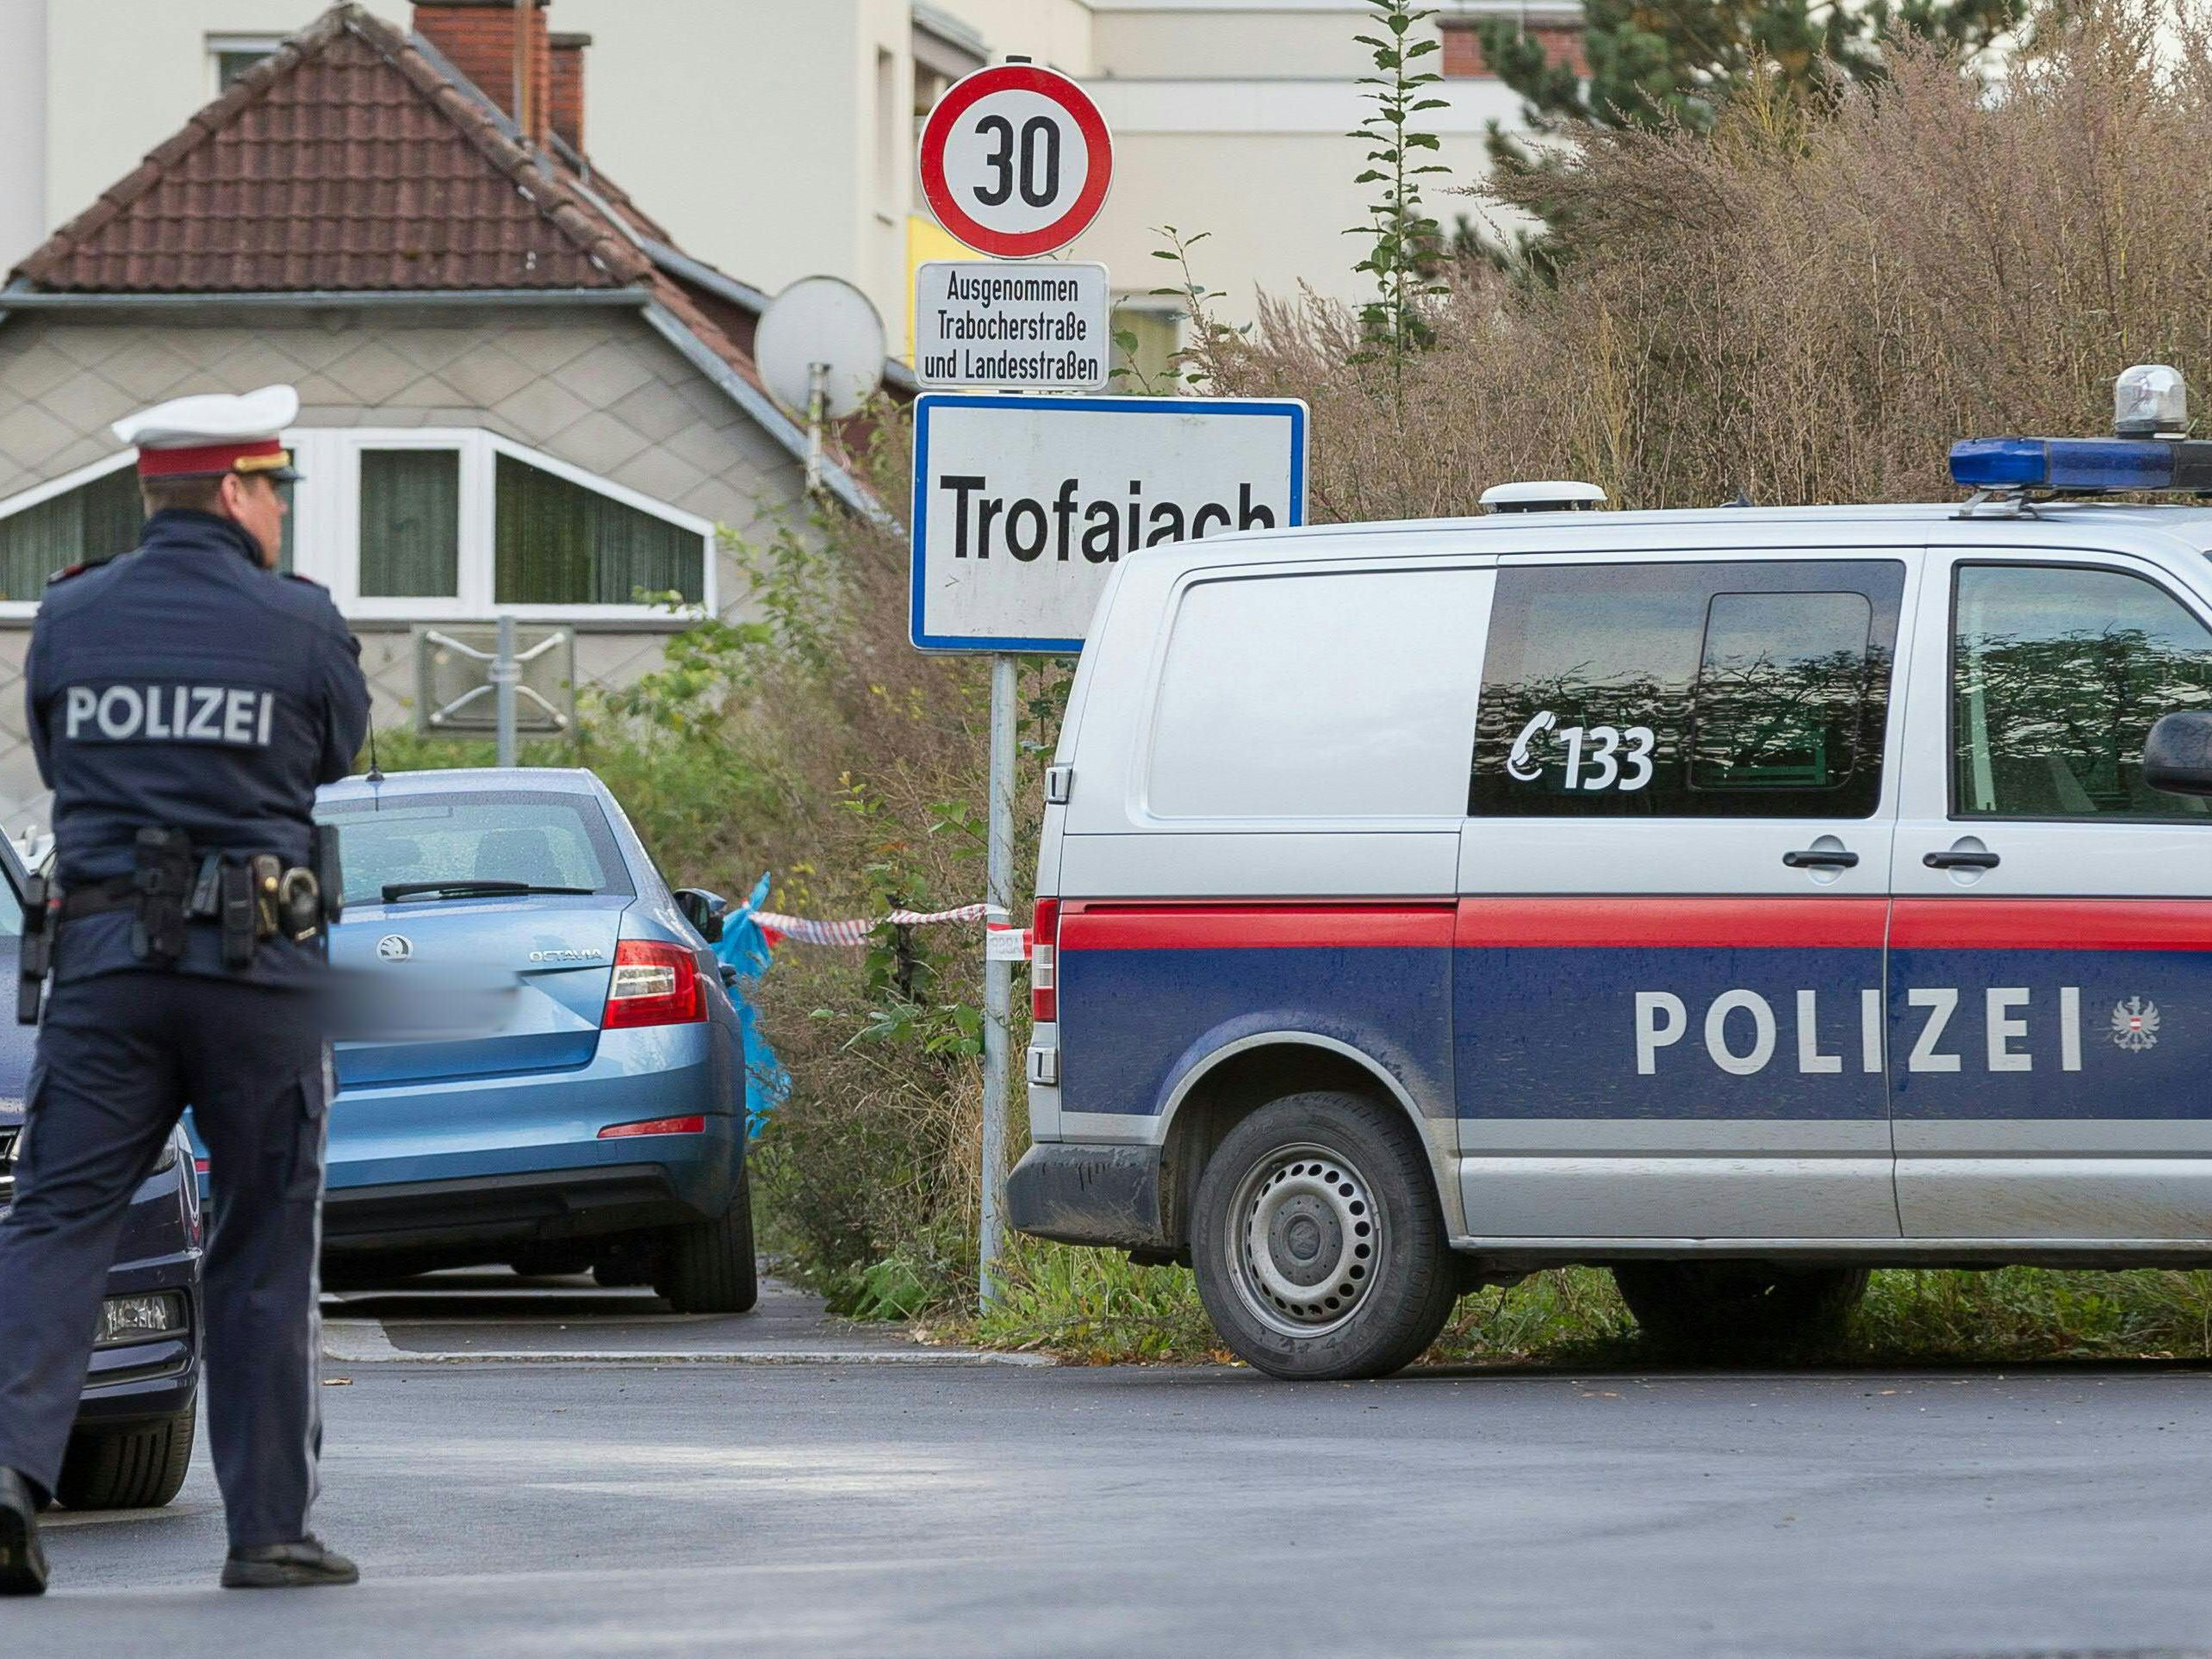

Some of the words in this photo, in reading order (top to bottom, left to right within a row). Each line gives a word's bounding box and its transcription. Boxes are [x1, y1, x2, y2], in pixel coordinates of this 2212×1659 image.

[973, 115, 1060, 207] 30
[947, 270, 1078, 308] Ausgenommen
[937, 309, 1087, 341] Trabocherstraße
[924, 348, 957, 379] und
[965, 348, 1098, 381] Landesstraßen
[66, 686, 272, 745] POLIZEI
[1560, 725, 1655, 791] 133
[529, 948, 603, 962] OCTAVIA
[1635, 986, 2082, 1076] POLIZEI
